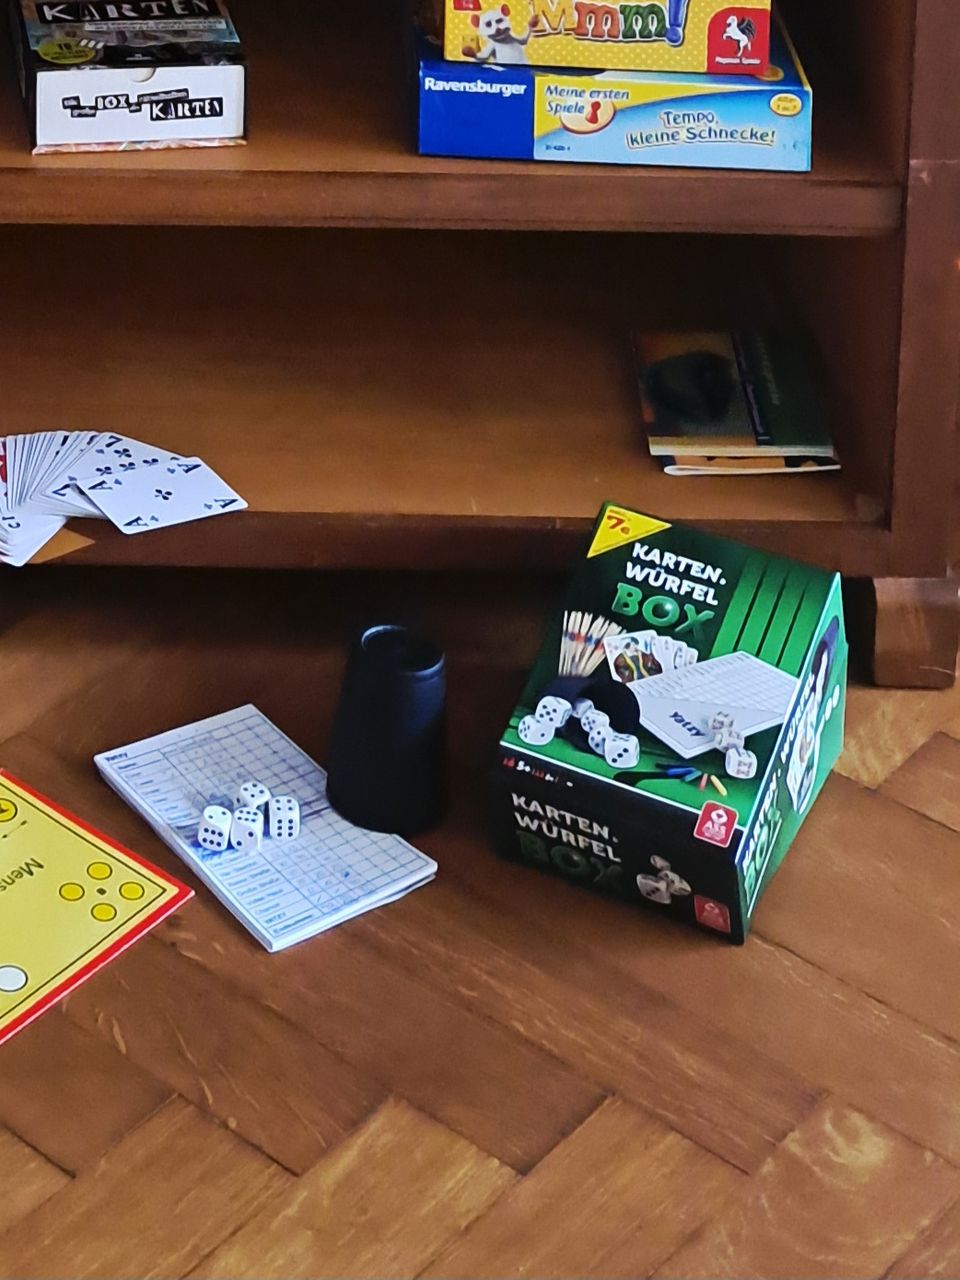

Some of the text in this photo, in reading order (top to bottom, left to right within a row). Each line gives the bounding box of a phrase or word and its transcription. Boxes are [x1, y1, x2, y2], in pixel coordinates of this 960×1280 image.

[424, 77, 527, 95] Ravensburger
[544, 85, 630, 100] Meine ersten
[152, 100, 220, 119] KARTEN
[546, 102, 585, 116] Spiele
[663, 111, 719, 125] Tempo,
[627, 126, 776, 147] kleine Schnecke!
[177, 461, 202, 474] A
[624, 562, 719, 606] WÜRFEL
[611, 583, 716, 639] BOX
[513, 810, 622, 864] WÜRFEL
